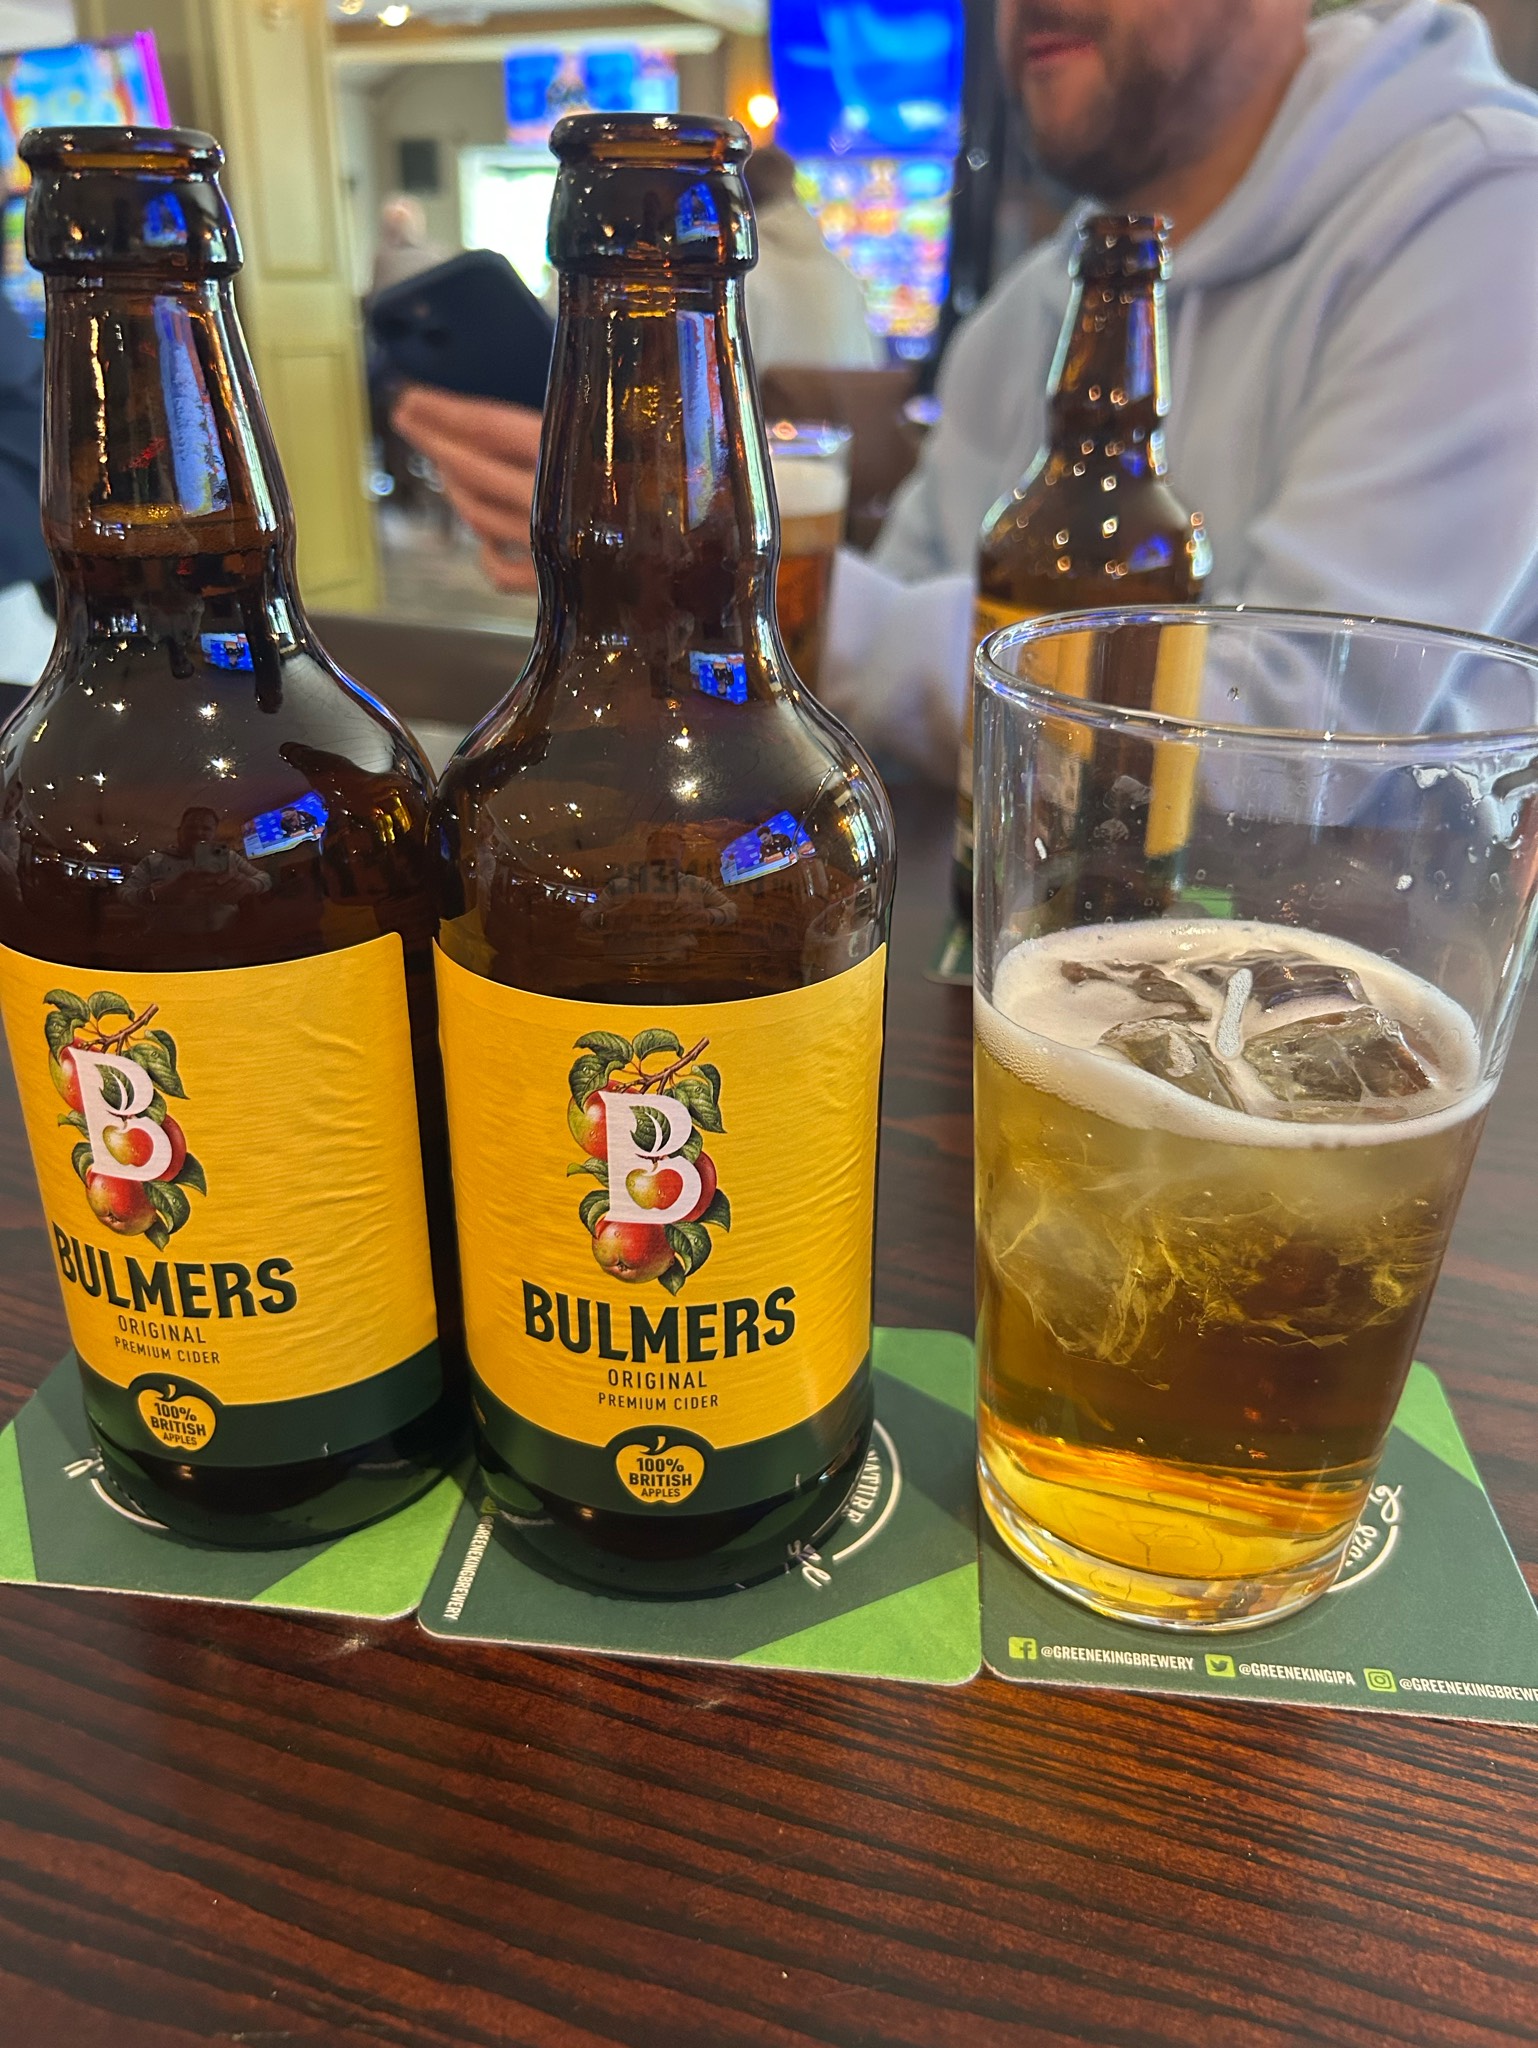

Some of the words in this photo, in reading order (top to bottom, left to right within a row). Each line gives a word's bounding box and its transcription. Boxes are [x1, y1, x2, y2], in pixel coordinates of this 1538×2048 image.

[53, 1221, 298, 1319] BULMERS
[118, 1315, 206, 1343] ORIGINAL
[522, 1279, 797, 1364] BULMERS
[114, 1336, 171, 1360] PREMIUM
[177, 1349, 220, 1364] CIDER
[608, 1369, 707, 1389] ORIGINAL
[599, 1392, 666, 1410] PREMIUM
[674, 1395, 718, 1410] CIDER
[154, 1402, 197, 1421] 100%
[150, 1416, 206, 1436] BRITISH
[163, 1432, 197, 1445] APPLES
[636, 1458, 684, 1472] 100%
[629, 1472, 692, 1487] BRITISH
[641, 1488, 680, 1497] APPLES
[442, 1515, 494, 1620] @GREENEKINGBREWERY
[1040, 1645, 1195, 1671] @GREENEKINGBREWERY
[1238, 1662, 1356, 1686] @GREENEKINGIPA
